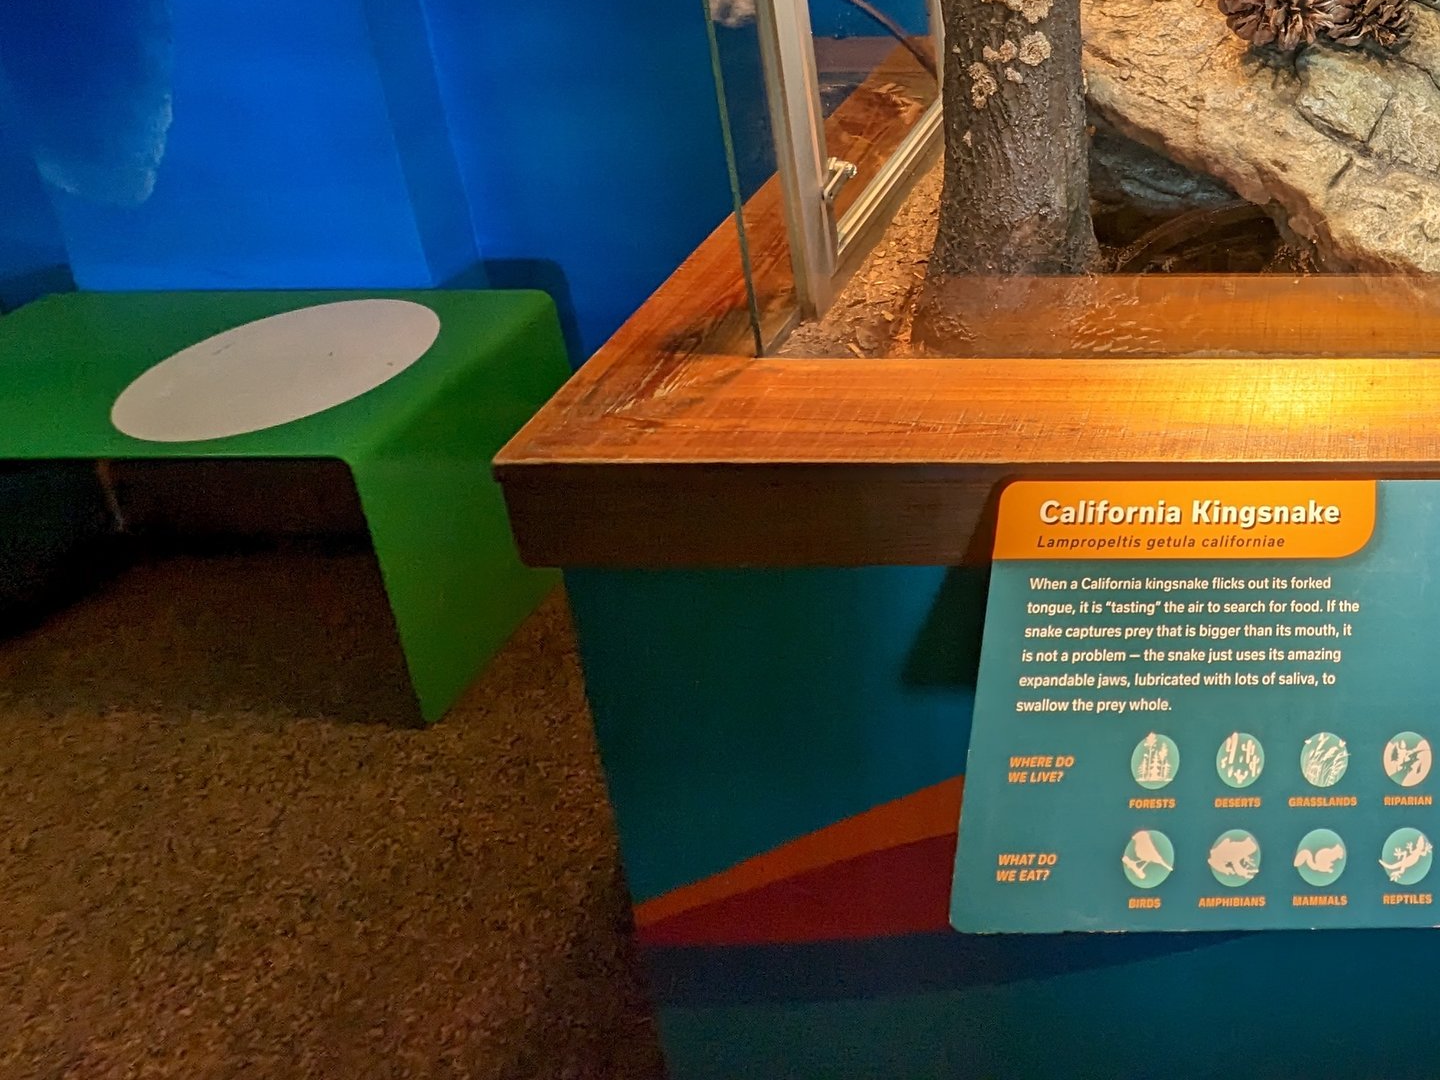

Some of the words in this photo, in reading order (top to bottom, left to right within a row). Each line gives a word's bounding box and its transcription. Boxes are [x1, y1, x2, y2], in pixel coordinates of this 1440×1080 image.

[1039, 499, 1180, 522] California
[1191, 499, 1339, 527] Kingsnake
[1037, 535, 1141, 550] Lampropeltis
[1146, 535, 1195, 550] getula
[1201, 534, 1284, 547] californiae
[1029, 577, 1067, 589] When
[1081, 577, 1141, 589] California
[1145, 577, 1208, 591] kingsnake
[1211, 576, 1244, 589] flicks
[1247, 577, 1269, 589] out
[1272, 576, 1287, 589] its
[1290, 576, 1331, 588] forked
[1027, 601, 1075, 615] tongue,
[1105, 600, 1161, 615] “tasting”
[1163, 600, 1184, 613] the
[1187, 600, 1204, 612] air
[1207, 601, 1220, 612] to
[1223, 600, 1265, 612] search
[1268, 599, 1287, 612] for
[1289, 599, 1322, 612] food.
[1326, 599, 1336, 612] If
[1338, 599, 1359, 612] the
[1024, 624, 1062, 637] snake
[1065, 625, 1121, 639] captures
[1124, 627, 1153, 639] prey
[1156, 624, 1182, 636] that
[1199, 624, 1241, 639] bigger
[1243, 623, 1272, 636] than
[1275, 623, 1291, 636] its
[1294, 623, 1339, 637] mouth,
[1035, 649, 1058, 661] not
[1071, 648, 1126, 663] problem
[1143, 648, 1164, 661] the
[1167, 648, 1205, 661] snake
[1207, 648, 1232, 663] just
[1235, 650, 1265, 660] uses
[1268, 647, 1284, 660] its
[1287, 647, 1341, 662] amazing
[1018, 673, 1095, 688] expandable
[1096, 673, 1130, 688] jaws,
[1134, 672, 1200, 685] lubricated
[1203, 672, 1231, 685] with
[1234, 672, 1258, 685] lots
[1261, 671, 1275, 684] of
[1278, 671, 1318, 686] saliva,
[1321, 672, 1335, 684] to
[1015, 698, 1069, 711] swallow
[1071, 698, 1093, 711] the
[1096, 701, 1126, 713] prey
[1128, 697, 1171, 710] whole.
[1010, 756, 1052, 767] WHERE
[1055, 756, 1074, 766] DO
[1008, 771, 1026, 782] WE
[1030, 770, 1063, 782] LIVE?
[1129, 798, 1175, 808] FORESTS
[1214, 797, 1260, 807] DESERTS
[1288, 796, 1357, 806] GRASSLANDS
[1383, 795, 1432, 805] RIPARIAN
[998, 854, 1035, 865] WHAT
[1037, 854, 1056, 865] DO
[996, 870, 1016, 881] WE
[1019, 868, 1049, 880] EAT?
[1128, 897, 1160, 908] BIRDS
[1198, 896, 1265, 907] AMPHIBIANS
[1292, 895, 1347, 905] MAMMALS
[1383, 893, 1431, 904] REPTILES
